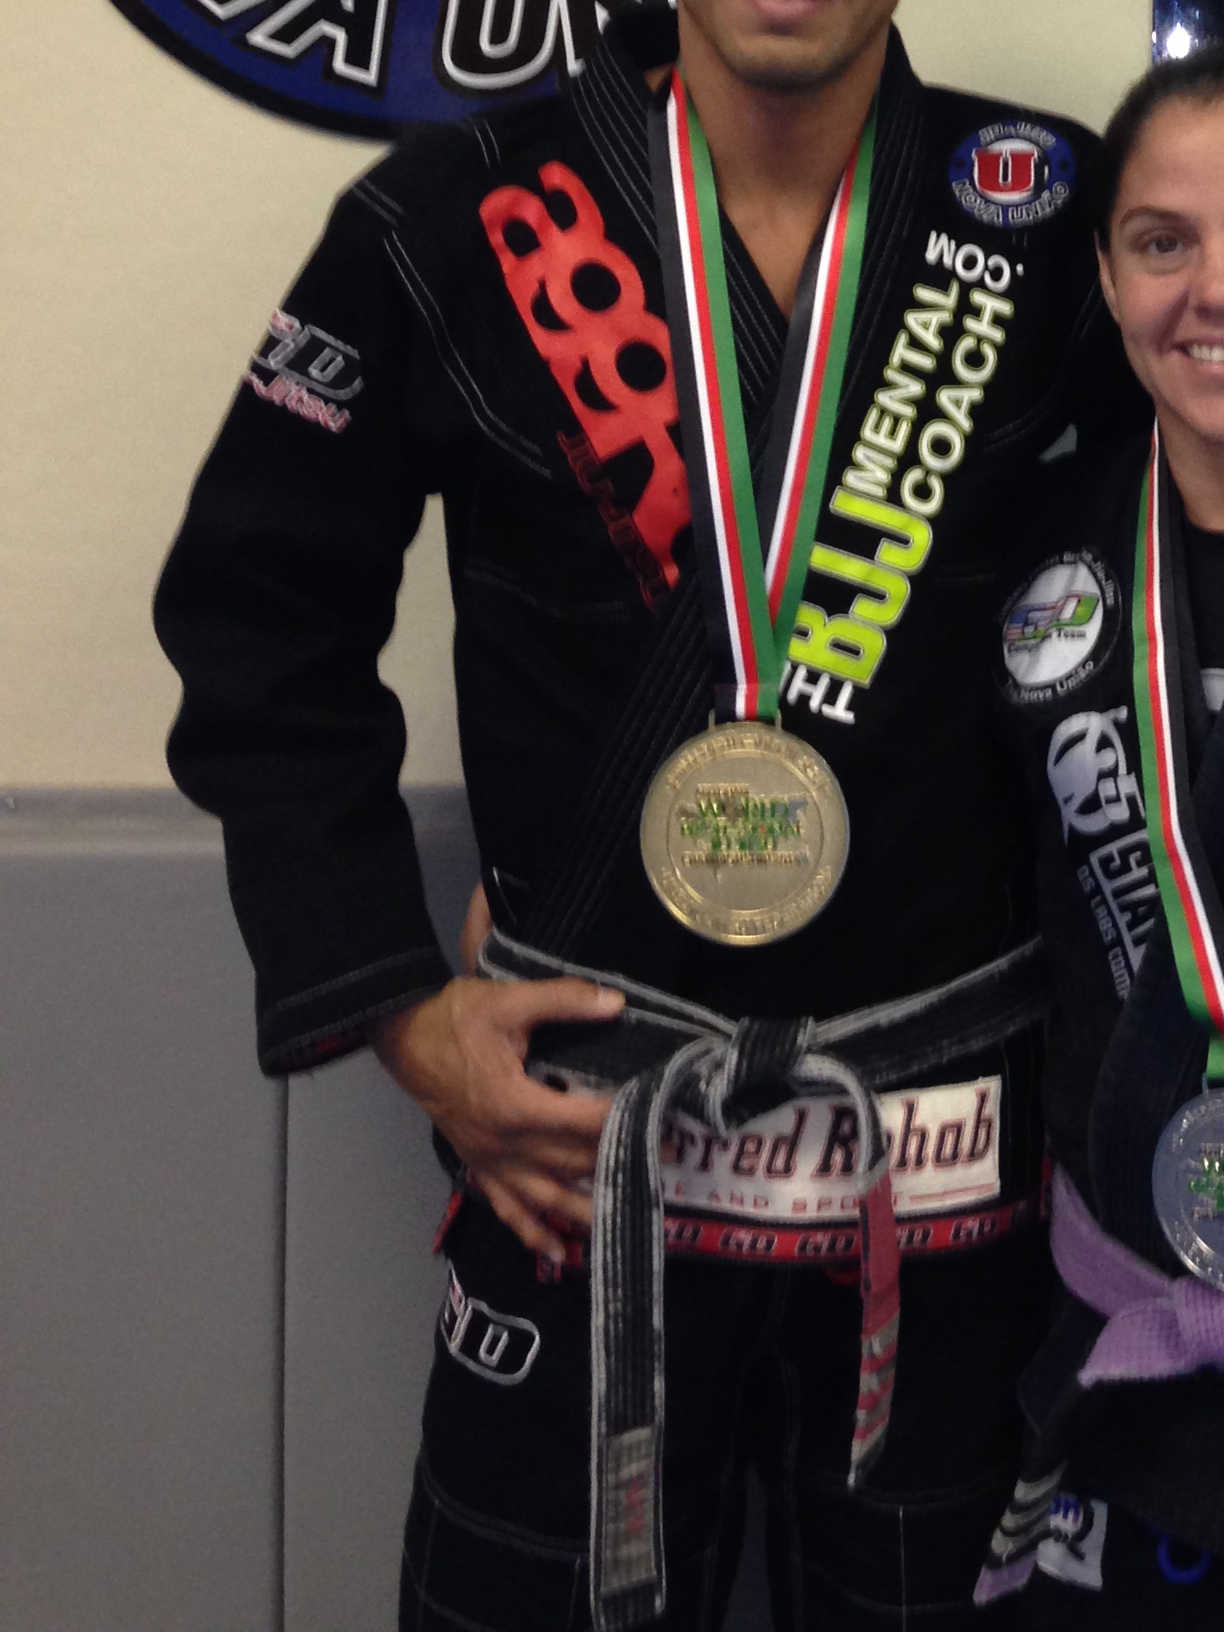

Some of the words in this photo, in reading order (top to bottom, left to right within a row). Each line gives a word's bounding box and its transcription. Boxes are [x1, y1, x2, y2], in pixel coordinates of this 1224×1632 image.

[952, 178, 1003, 226] NOVA
[925, 229, 1024, 294] .COM
[841, 278, 961, 501] MENTAL
[900, 286, 1015, 520] COACH
[787, 485, 934, 690] BJJ
[779, 659, 856, 725] TH
[660, 1104, 810, 1181] rred
[811, 1085, 996, 1182] Rhab
